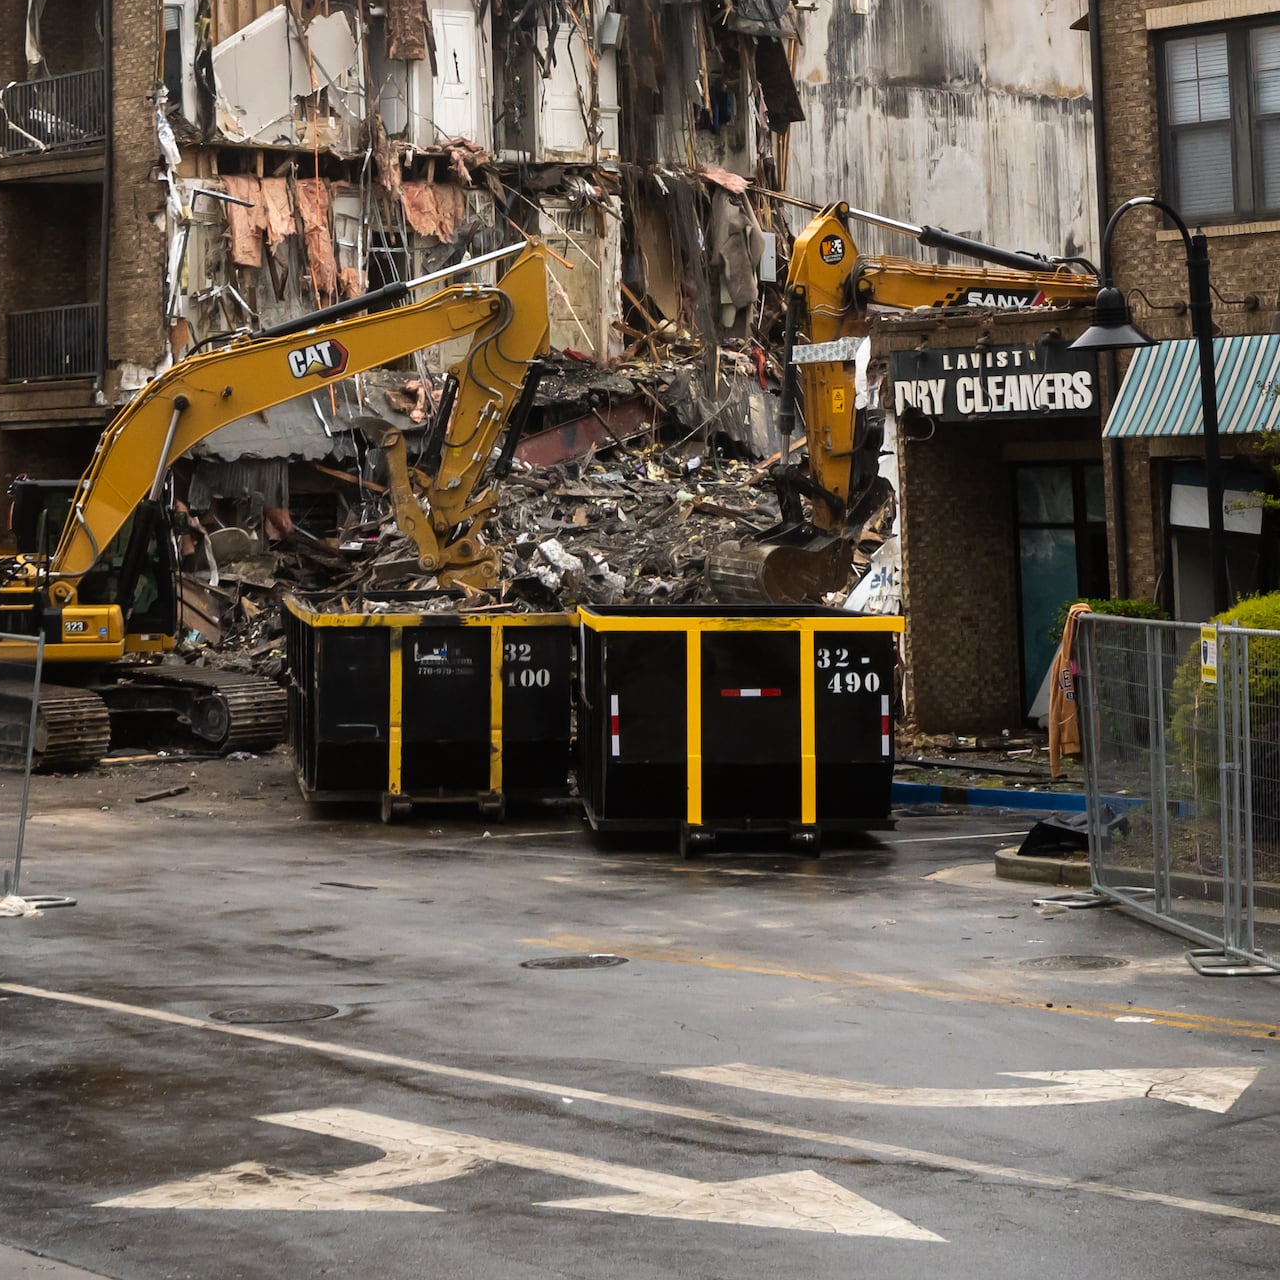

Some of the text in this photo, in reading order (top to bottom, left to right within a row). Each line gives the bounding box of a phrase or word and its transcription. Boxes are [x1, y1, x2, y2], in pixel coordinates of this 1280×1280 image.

[967, 291, 1028, 307] SANY
[288, 340, 333, 378] CAT
[942, 349, 1037, 371] LAVIST
[894, 370, 1093, 417] DRY CLEANERS
[64, 621, 83, 632] 323
[504, 643, 532, 662] 32
[827, 672, 880, 694] 490
